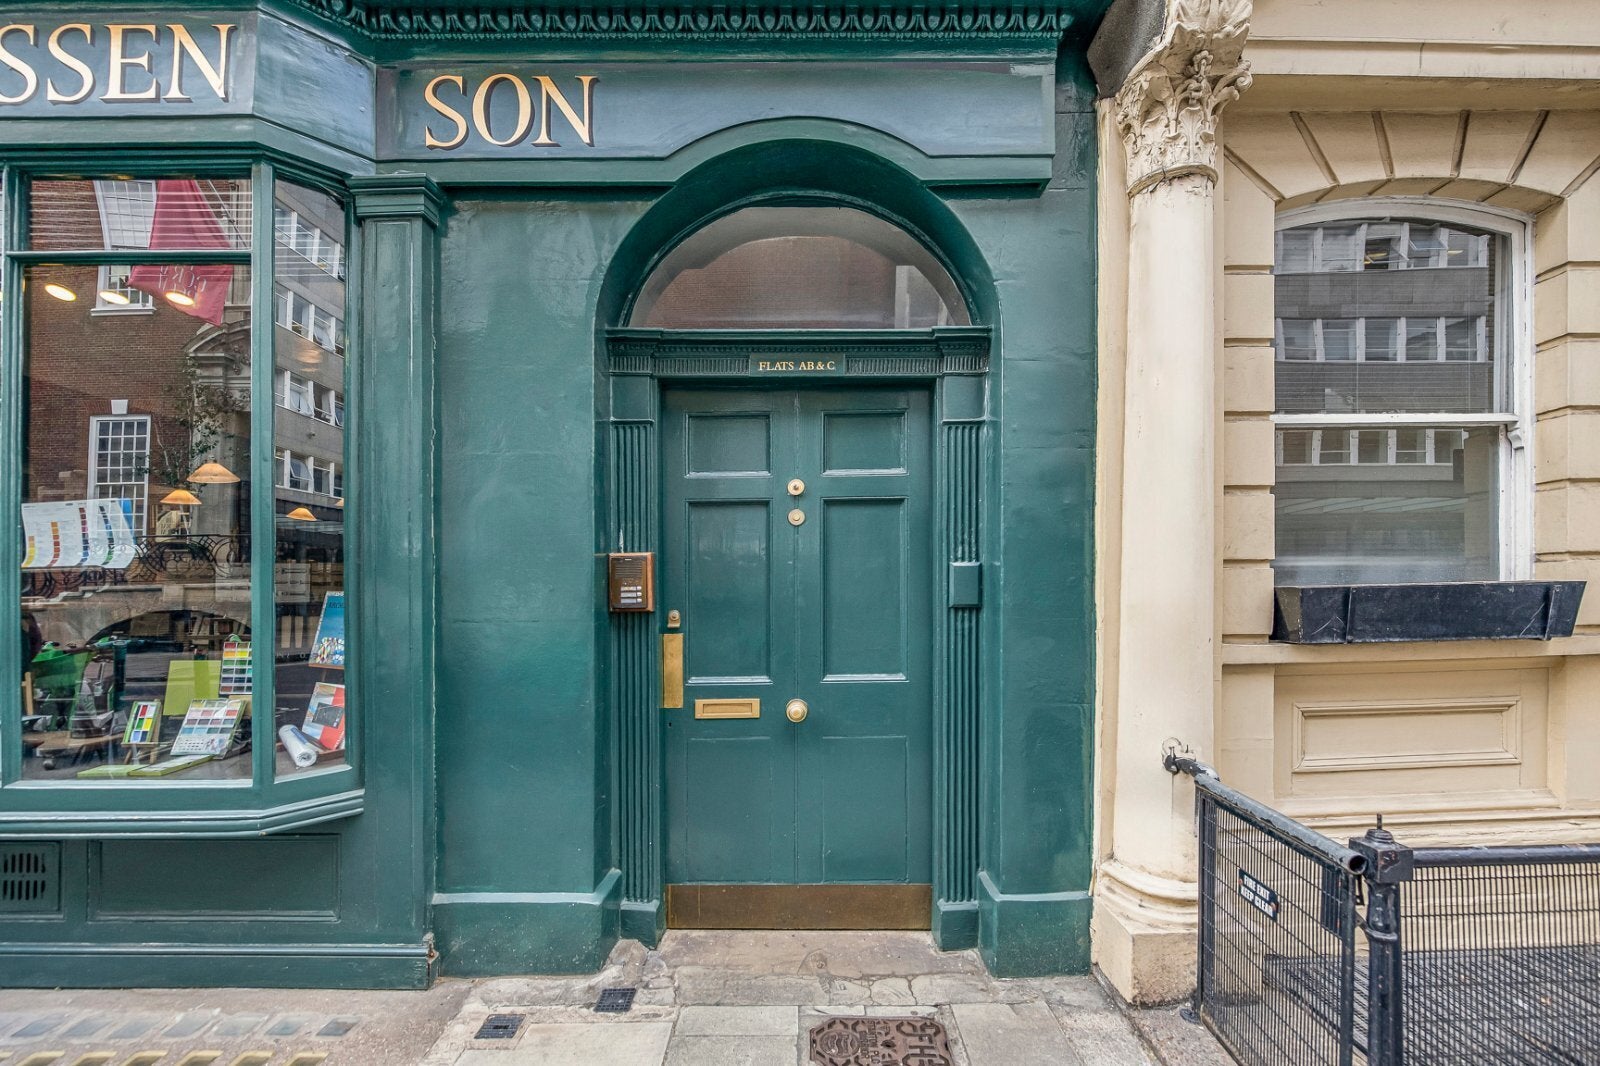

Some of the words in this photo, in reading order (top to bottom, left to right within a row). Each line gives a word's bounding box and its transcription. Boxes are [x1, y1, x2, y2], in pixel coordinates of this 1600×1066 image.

[423, 73, 599, 149] SON
[758, 361, 794, 371] FLATS
[1240, 885, 1255, 902] KEEP
[1243, 874, 1257, 892] FIRE
[1256, 883, 1270, 901] EXIT
